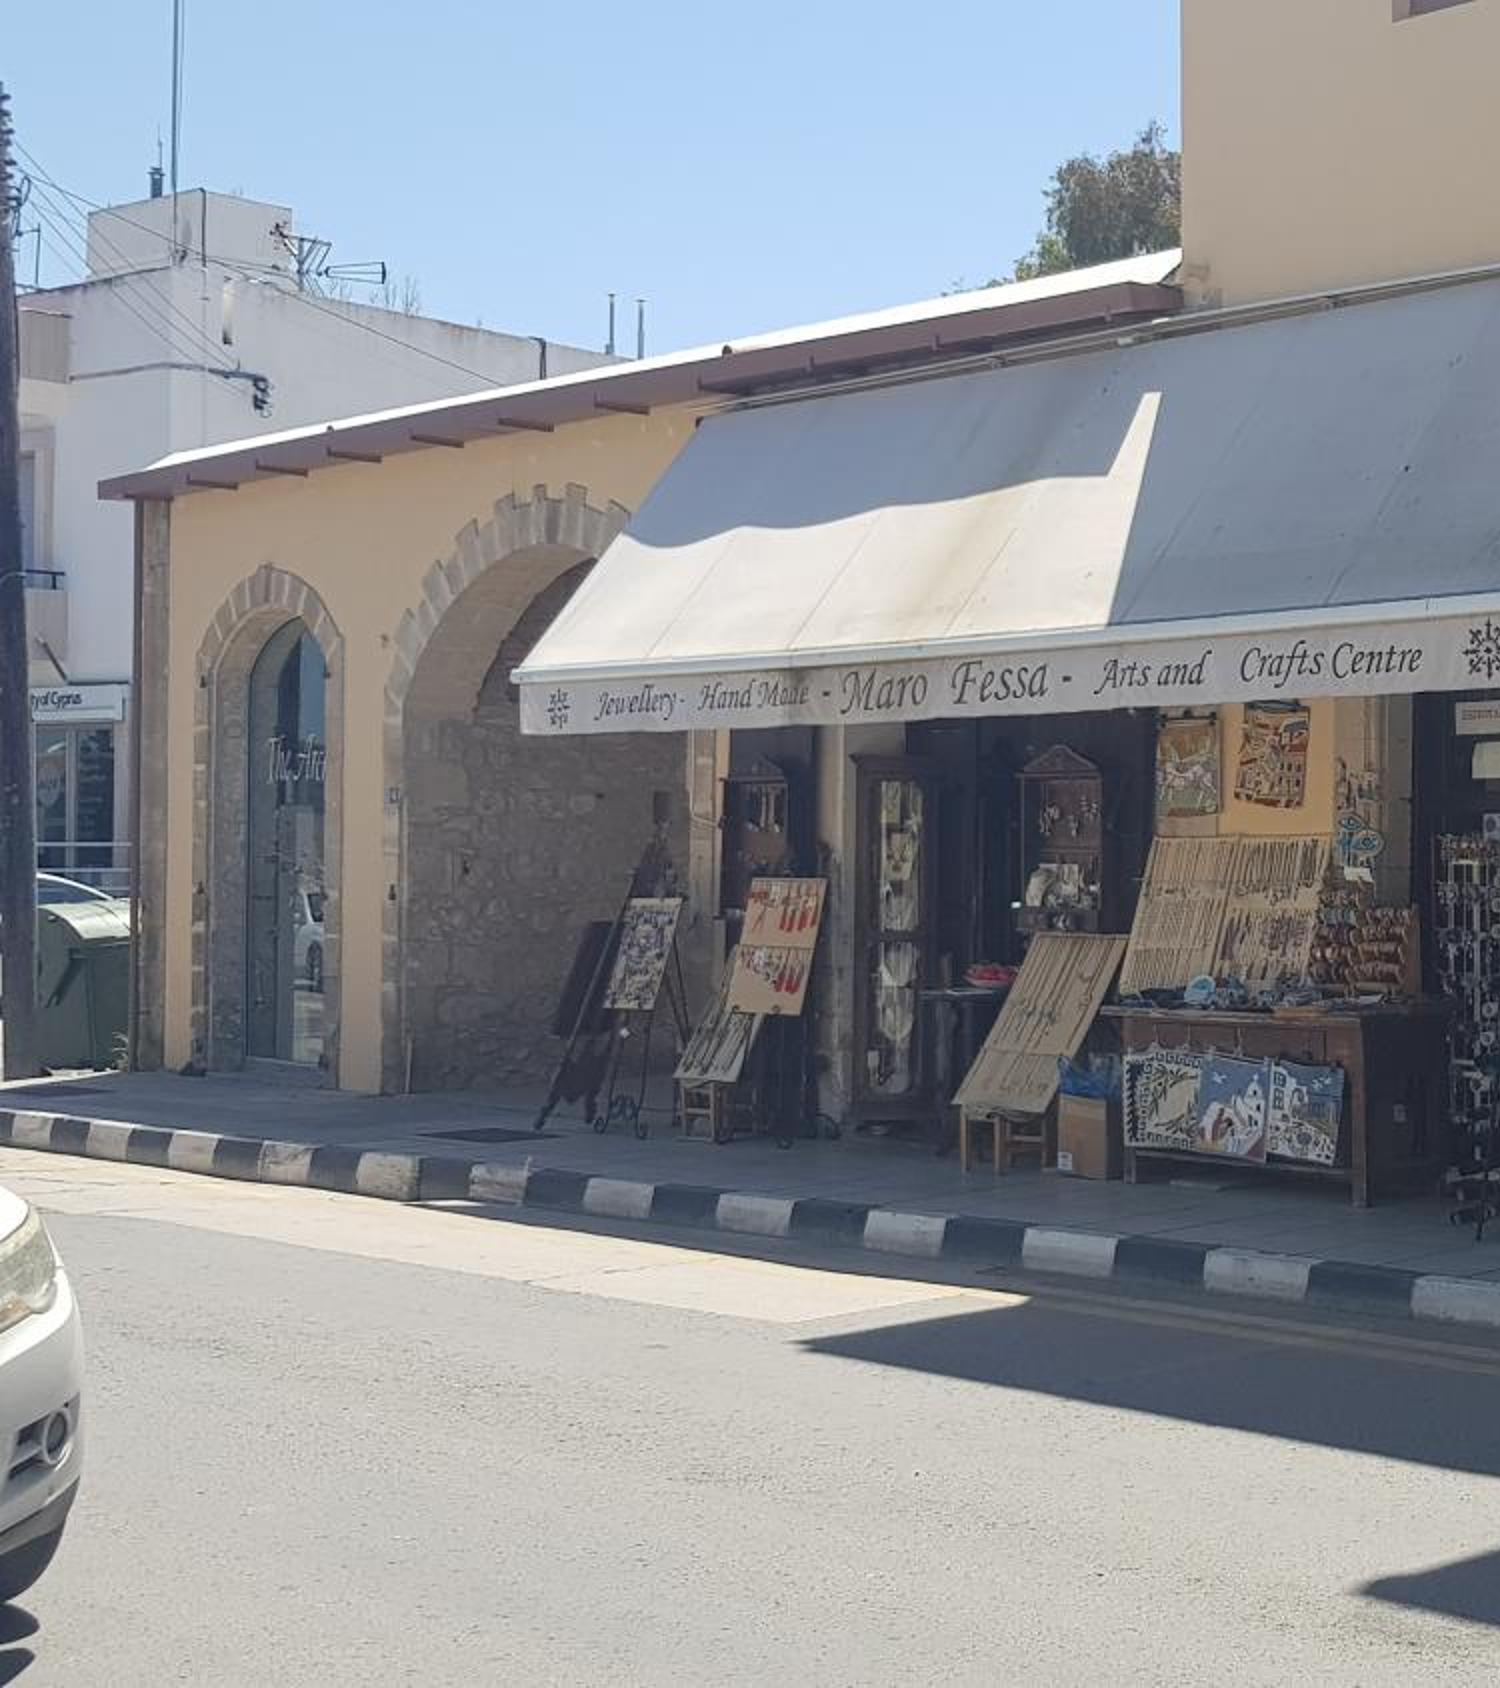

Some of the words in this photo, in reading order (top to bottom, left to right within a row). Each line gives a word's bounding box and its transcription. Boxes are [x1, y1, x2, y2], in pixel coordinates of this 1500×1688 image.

[698, 678, 757, 711] Hand
[840, 667, 929, 714] Maro
[951, 660, 1049, 705] Fessa
[1093, 658, 1151, 695] Arts
[1157, 649, 1212, 686] and
[1240, 640, 1325, 688] Crafts
[1332, 642, 1423, 679] Centre
